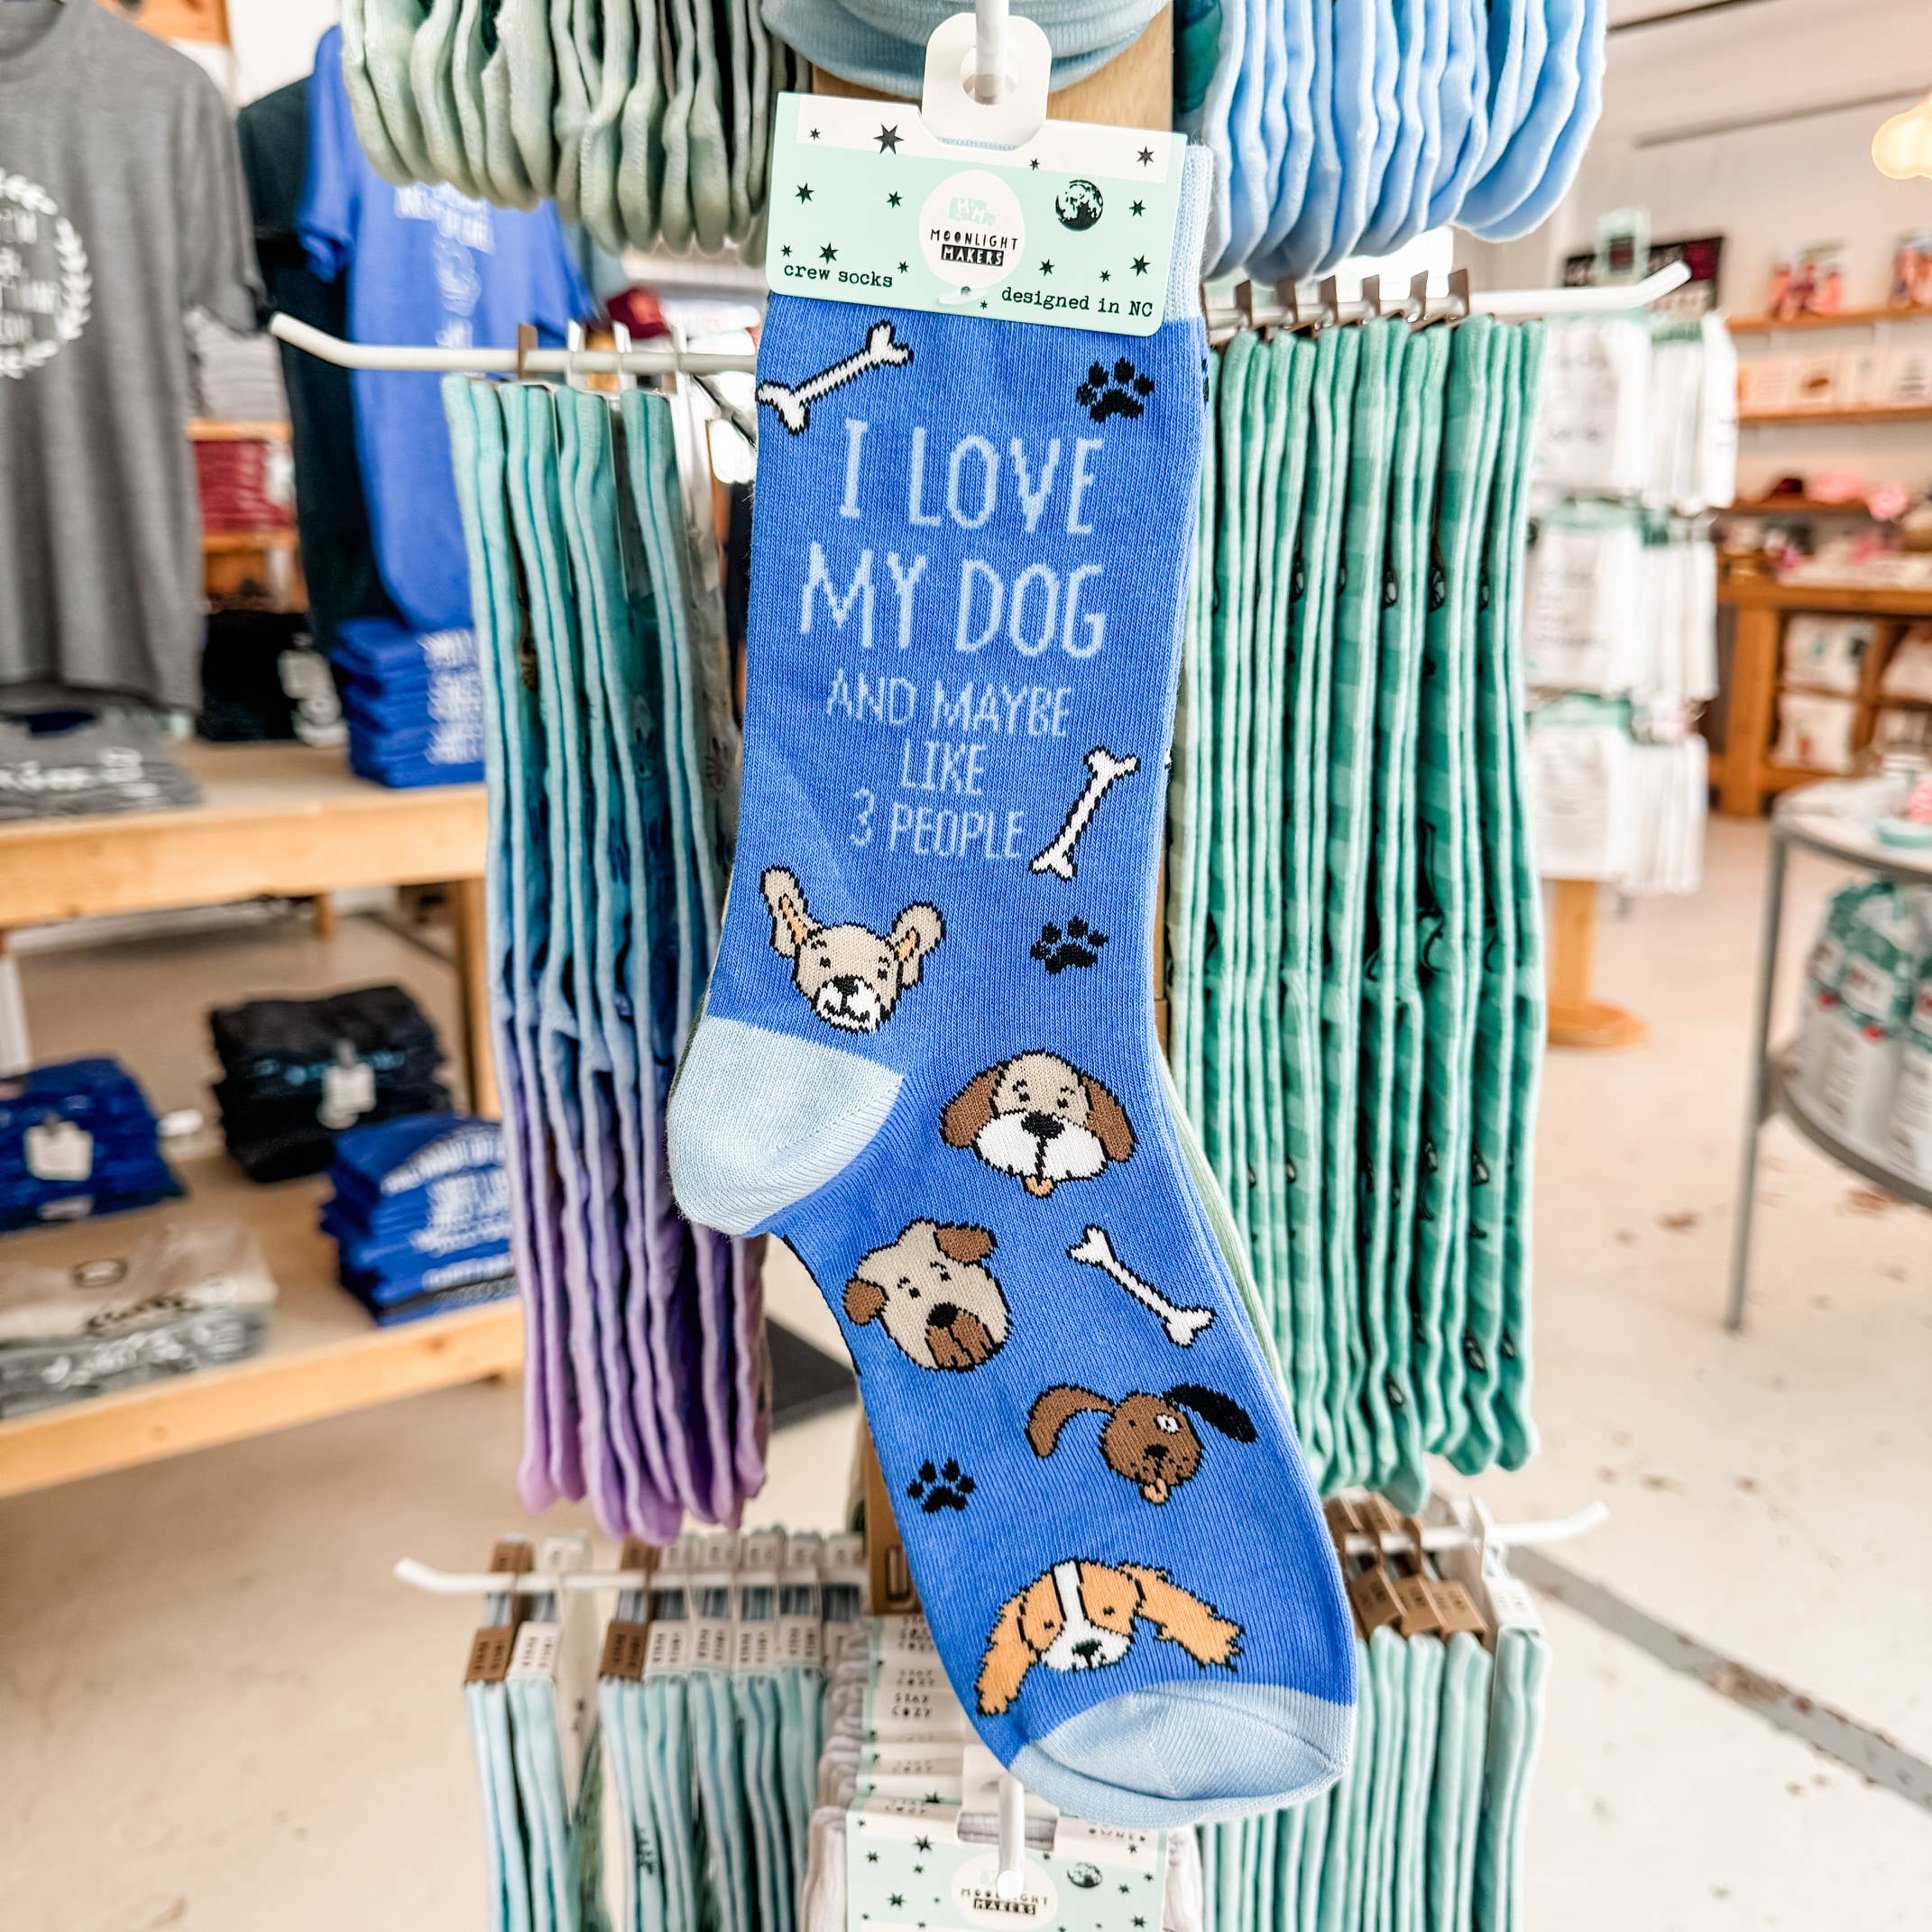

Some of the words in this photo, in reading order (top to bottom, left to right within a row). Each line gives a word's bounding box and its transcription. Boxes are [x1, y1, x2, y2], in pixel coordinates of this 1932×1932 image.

[930, 228, 1018, 251] MOONLIGHT
[942, 245, 1004, 267] MAKERS
[783, 264, 831, 281] crew
[838, 271, 893, 288] socks
[1001, 287, 1090, 310] designed
[1097, 298, 1120, 314] in
[1128, 300, 1154, 317] NC
[839, 419, 869, 520] I
[907, 426, 1105, 535] LOVE
[799, 541, 926, 649] MY
[953, 559, 1108, 659] DOG
[825, 668, 917, 727] AND
[931, 683, 1073, 738] MAYBE
[900, 738, 989, 796] LIKE
[851, 788, 876, 847] 3
[889, 802, 1026, 860] PEOPLE
